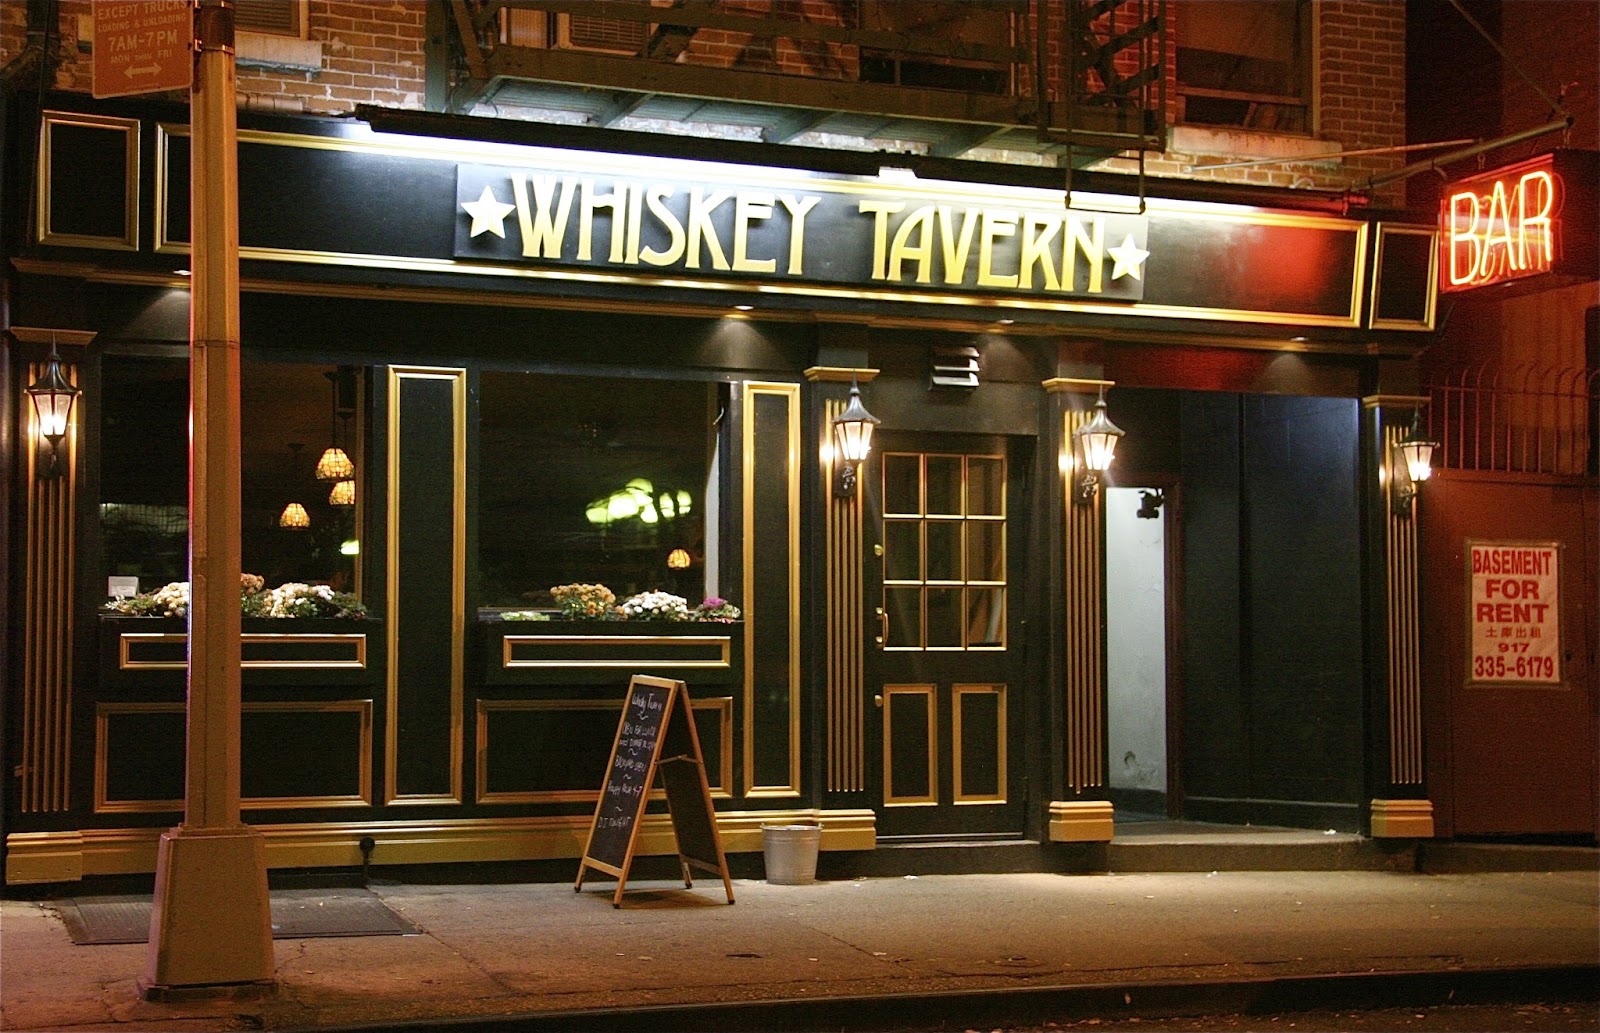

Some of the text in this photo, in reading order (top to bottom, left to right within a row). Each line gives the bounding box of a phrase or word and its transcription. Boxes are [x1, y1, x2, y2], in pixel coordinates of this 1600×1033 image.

[98, 0, 186, 20] EXCEPT TRUCKS
[98, 13, 186, 33] LOADING & UNLOADING
[110, 54, 130, 63] MON
[158, 49, 172, 60] FRI
[510, 172, 1106, 294] WHISKEY TAVERN
[1450, 170, 1553, 285] BAR
[1473, 549, 1552, 575] BASEMENT
[1486, 579, 1539, 600] FOR
[1477, 603, 1549, 623] RENT
[1498, 643, 1530, 653] 917
[1475, 655, 1554, 678] 335-6179
